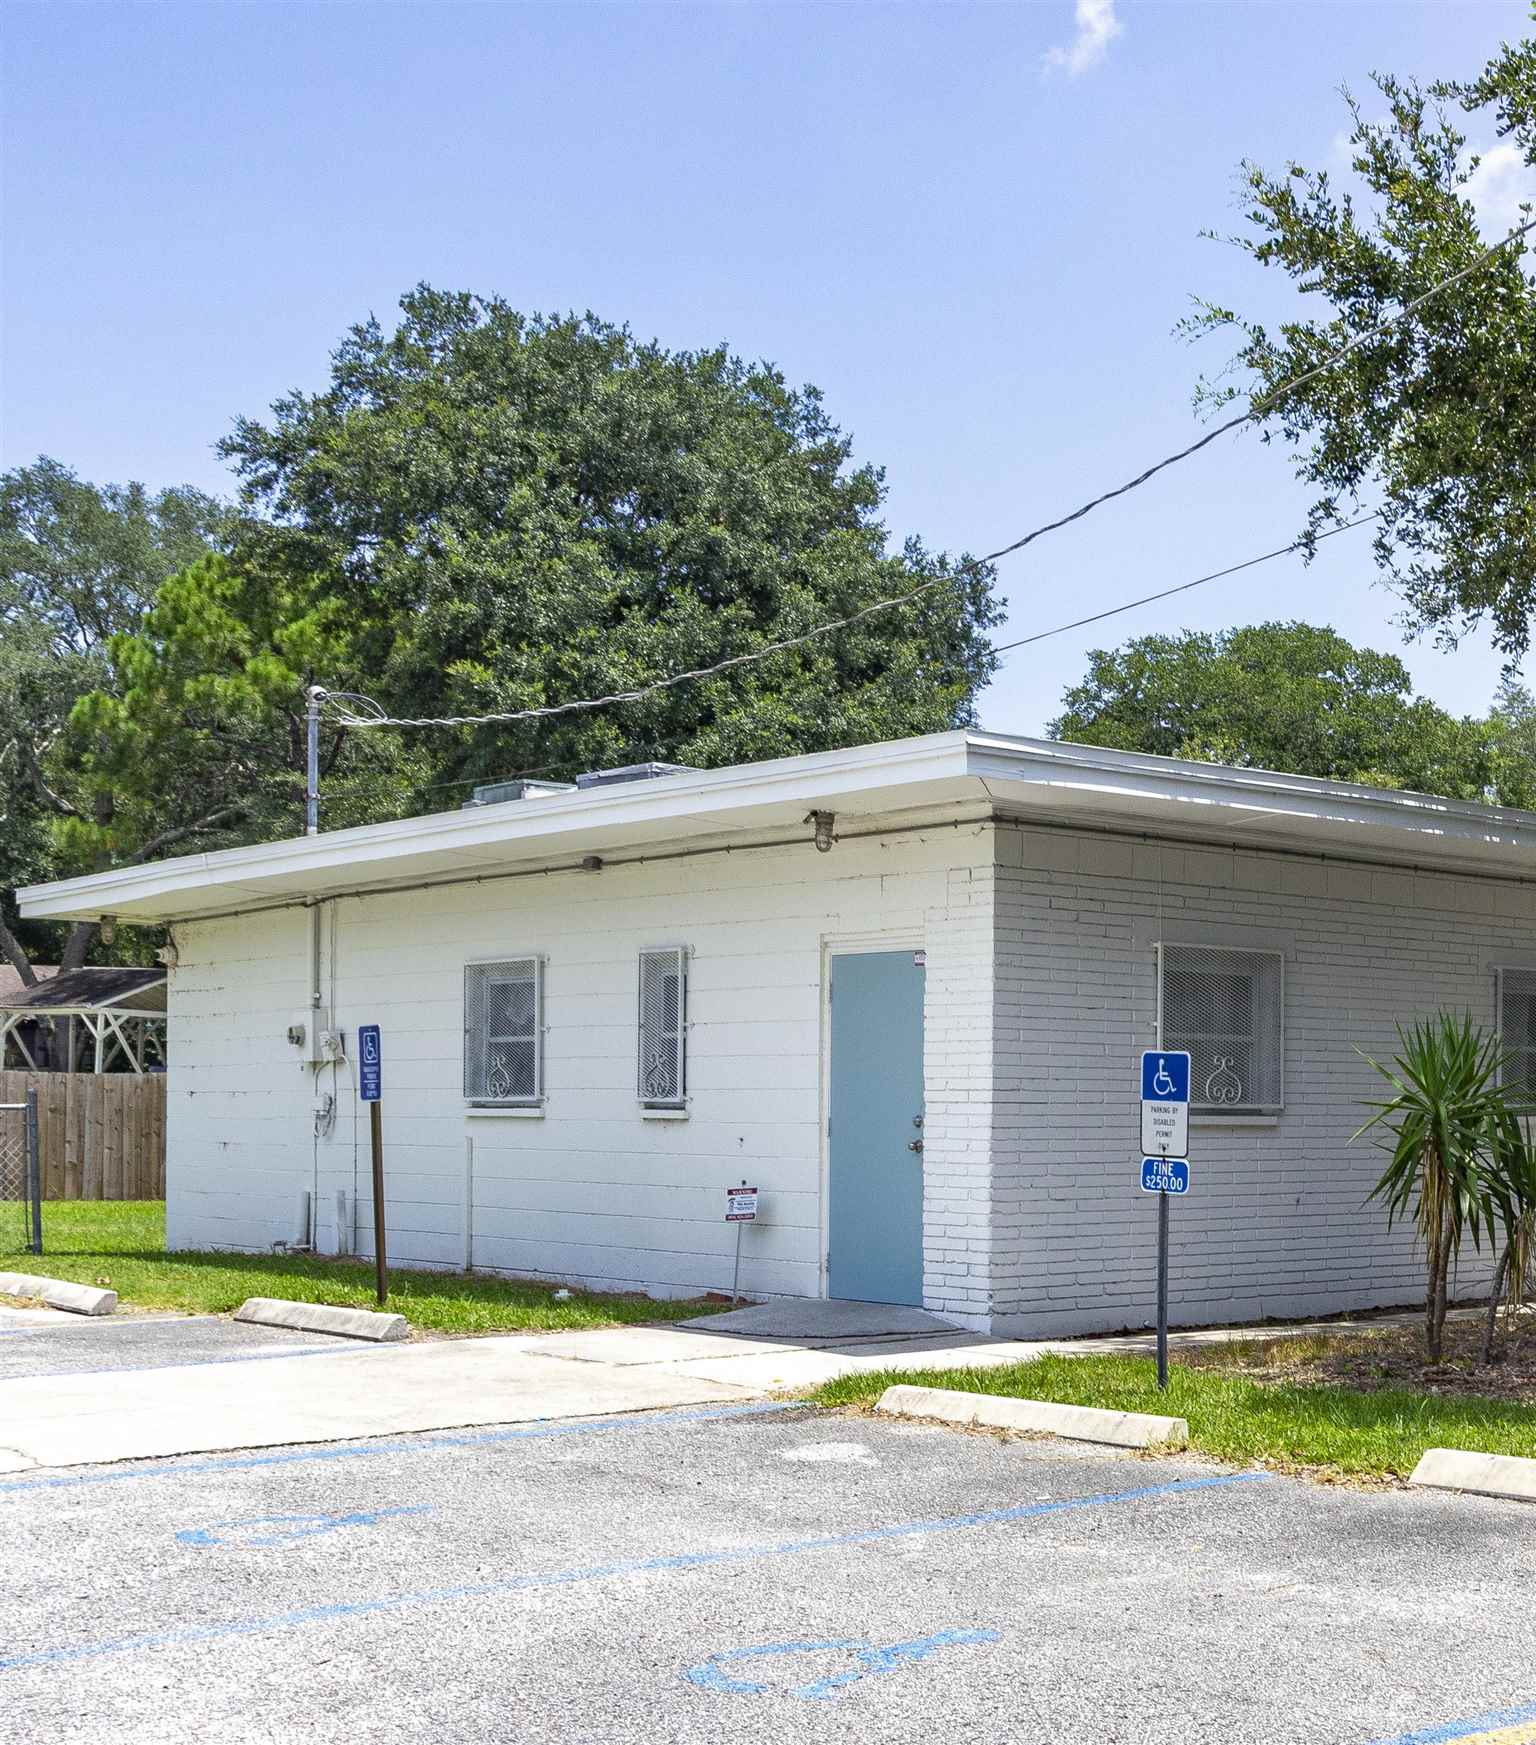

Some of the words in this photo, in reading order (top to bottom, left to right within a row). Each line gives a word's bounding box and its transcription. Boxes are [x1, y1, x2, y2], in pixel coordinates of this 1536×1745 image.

[1150, 1106, 1171, 1114] PARKING
[1172, 1107, 1178, 1115] BY
[1153, 1118, 1176, 1127] DISABLED
[1155, 1130, 1173, 1138] PERMIT
[1153, 1161, 1174, 1177] FINE
[1145, 1175, 1183, 1191] $250.00
